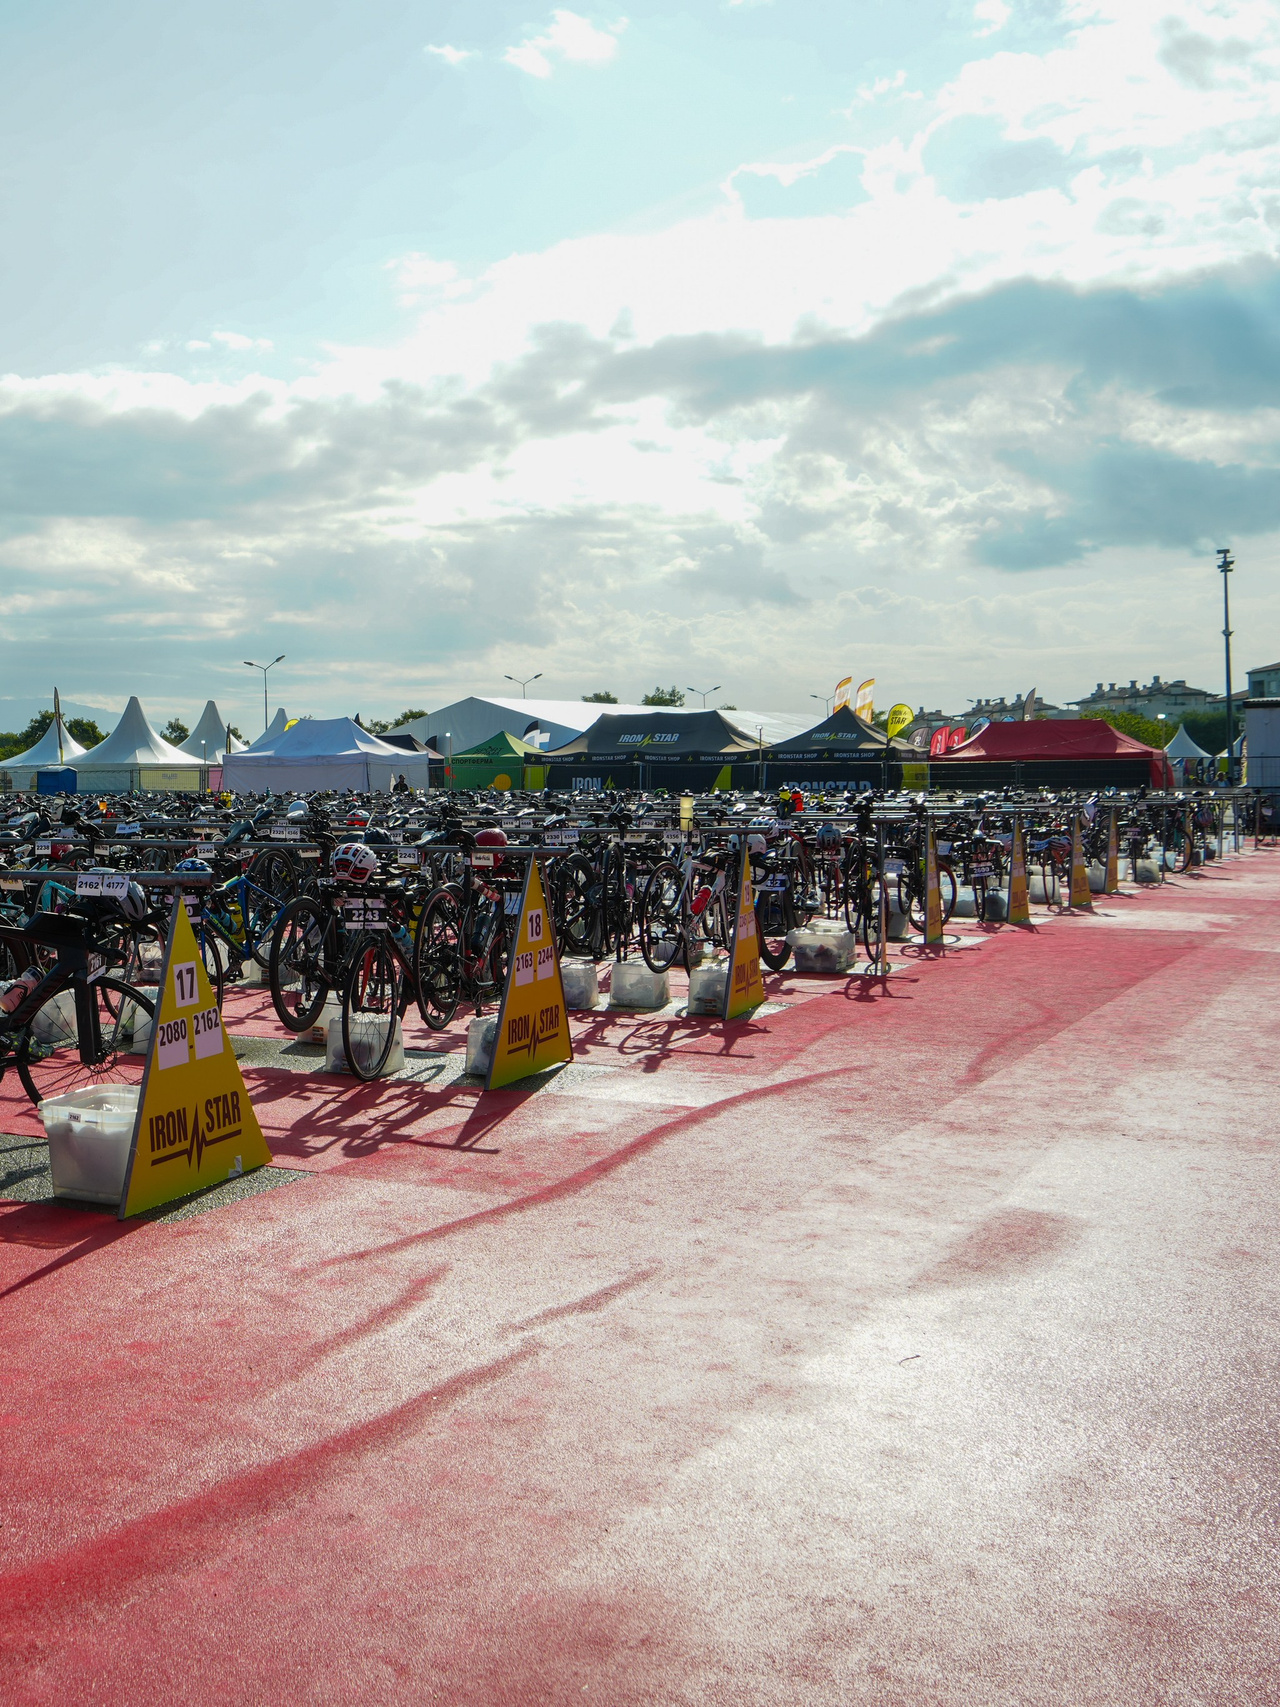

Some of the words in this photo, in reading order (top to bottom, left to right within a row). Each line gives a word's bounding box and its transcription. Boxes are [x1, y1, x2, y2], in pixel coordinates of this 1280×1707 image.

[618, 734, 644, 742] IRON
[652, 733, 680, 742] STAR
[571, 777, 602, 790] IRON
[78, 880, 99, 889] 2162
[106, 881, 125, 889] 4177
[351, 910, 380, 922] 2243
[528, 915, 542, 937] 18
[516, 951, 533, 972] 2163
[538, 945, 554, 965] 2244
[176, 967, 195, 1000] 17
[158, 1018, 187, 1046] 2080
[193, 1009, 220, 1036] 2162
[508, 1014, 530, 1045] IRON
[539, 1004, 560, 1034] STAR
[149, 1107, 189, 1153] IRON
[205, 1091, 242, 1133] STAR
